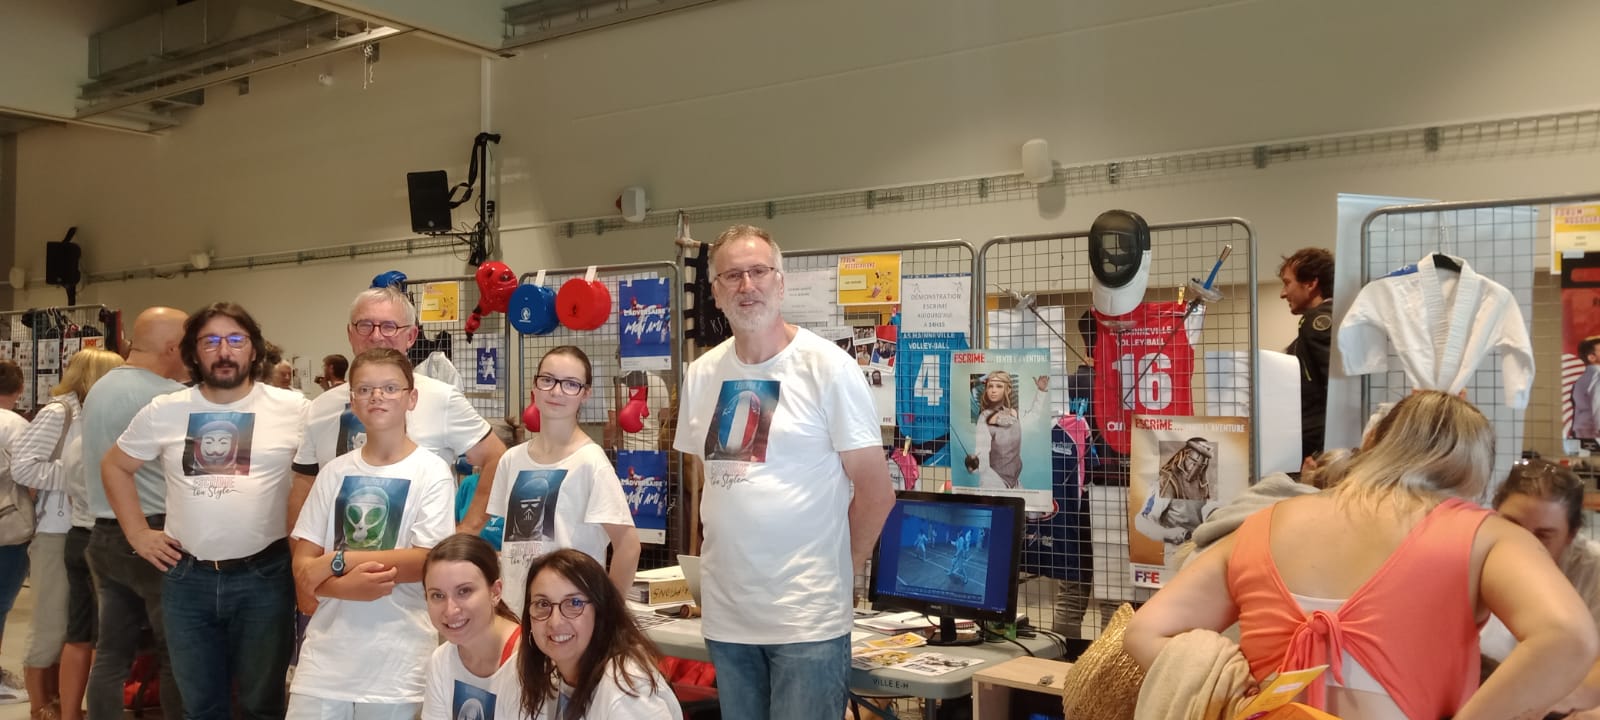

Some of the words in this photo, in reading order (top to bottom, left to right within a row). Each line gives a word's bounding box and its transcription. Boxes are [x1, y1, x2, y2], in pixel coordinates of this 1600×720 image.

[914, 354, 943, 406] 4
[1112, 353, 1172, 410] 16
[1135, 570, 1160, 584] FFE
